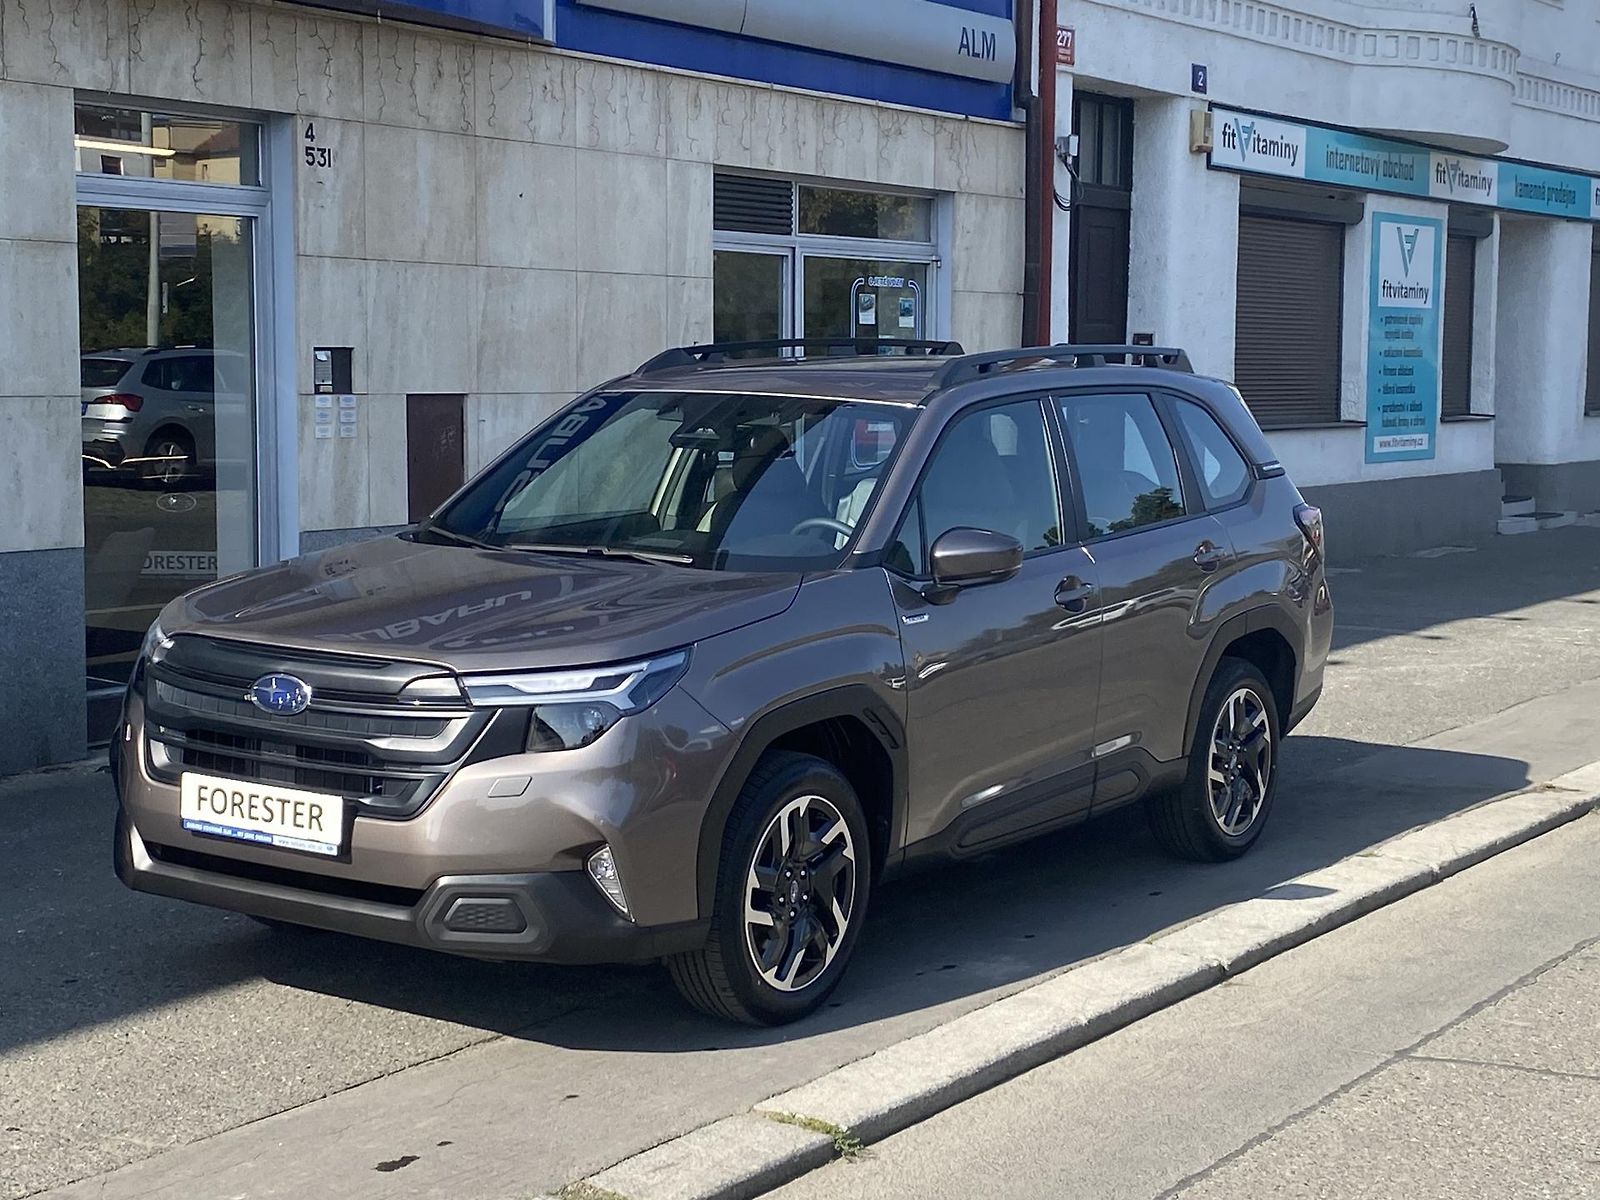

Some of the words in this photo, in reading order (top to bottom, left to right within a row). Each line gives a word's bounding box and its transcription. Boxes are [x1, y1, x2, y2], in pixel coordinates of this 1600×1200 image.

[958, 26, 996, 62] ALM
[1056, 30, 1072, 48] 277
[1197, 71, 1204, 87] 2
[304, 122, 316, 142] 4
[305, 146, 332, 168] 531
[1326, 144, 1380, 181] internetový
[1382, 152, 1415, 182] obchod
[1382, 279, 1429, 304] fitvitaminy
[198, 784, 324, 832] FORESTER
